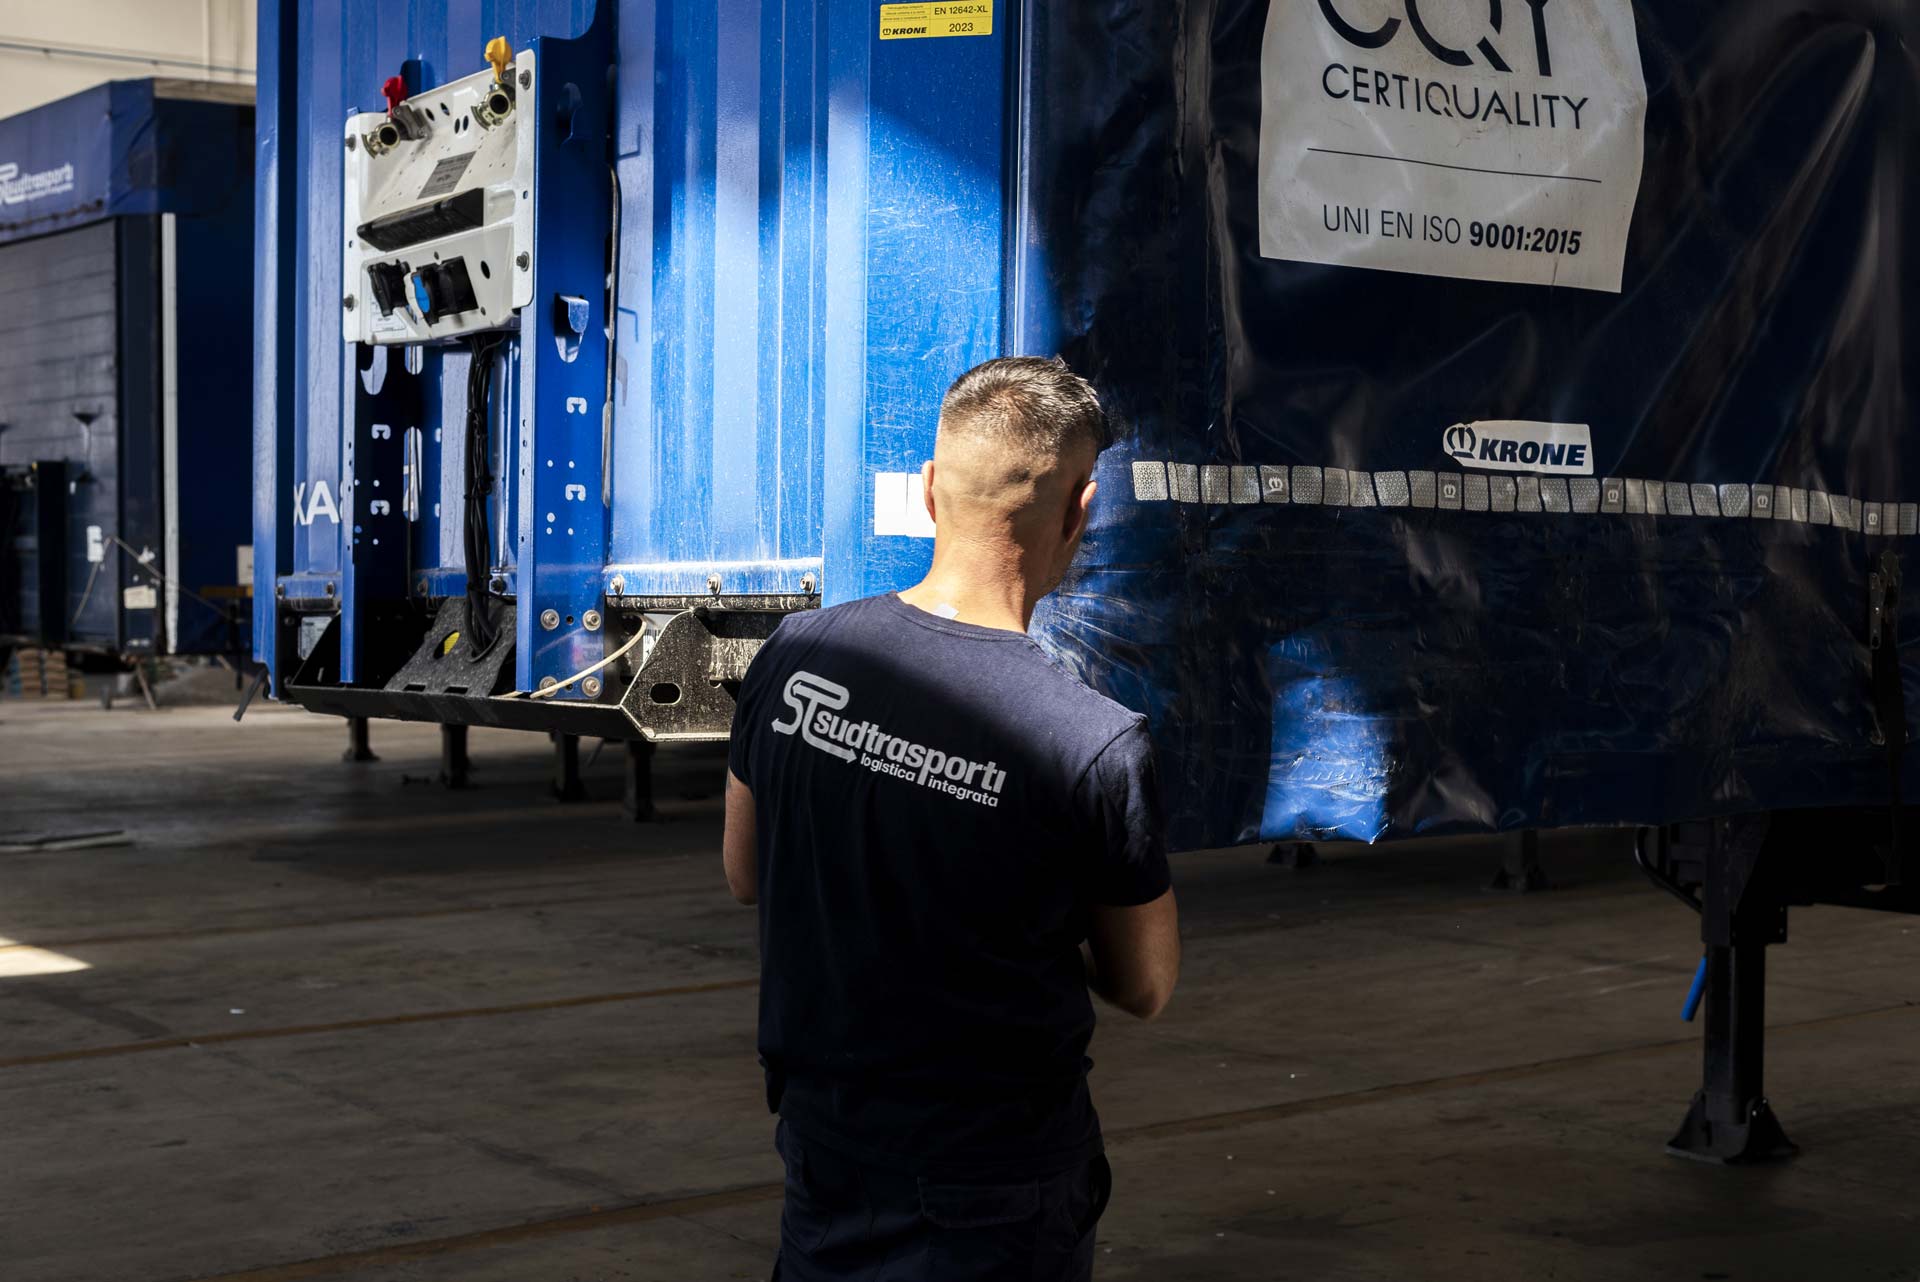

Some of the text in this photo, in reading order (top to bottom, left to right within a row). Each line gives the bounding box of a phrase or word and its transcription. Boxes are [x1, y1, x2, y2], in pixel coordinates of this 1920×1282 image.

[892, 26, 927, 35] KRONE
[934, 7, 947, 15] EN
[949, 5, 988, 15] 12642-XL
[949, 23, 974, 32] 2023
[1322, 63, 1589, 129] CERTIQUALITY
[1323, 204, 1582, 255] UNI EN ISO 9001:2015
[1479, 438, 1587, 467] KRONE
[294, 480, 343, 526] XA
[813, 710, 1007, 794] sudtrasporti
[860, 752, 999, 808] logistica integrata
